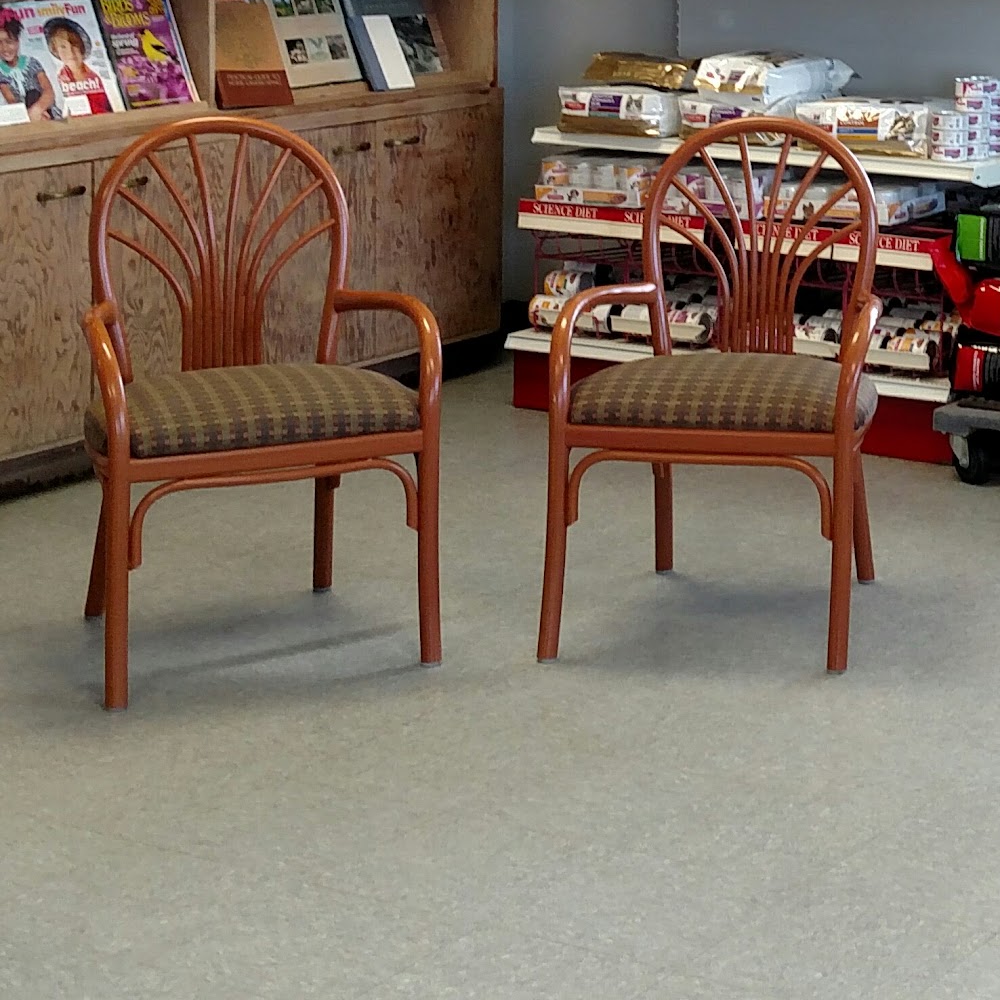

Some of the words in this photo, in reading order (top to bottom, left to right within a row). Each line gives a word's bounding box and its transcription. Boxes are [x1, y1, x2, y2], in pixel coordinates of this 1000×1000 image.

[532, 202, 574, 217] SCIENCE
[575, 206, 599, 219] DIET
[894, 237, 920, 252] DIET
